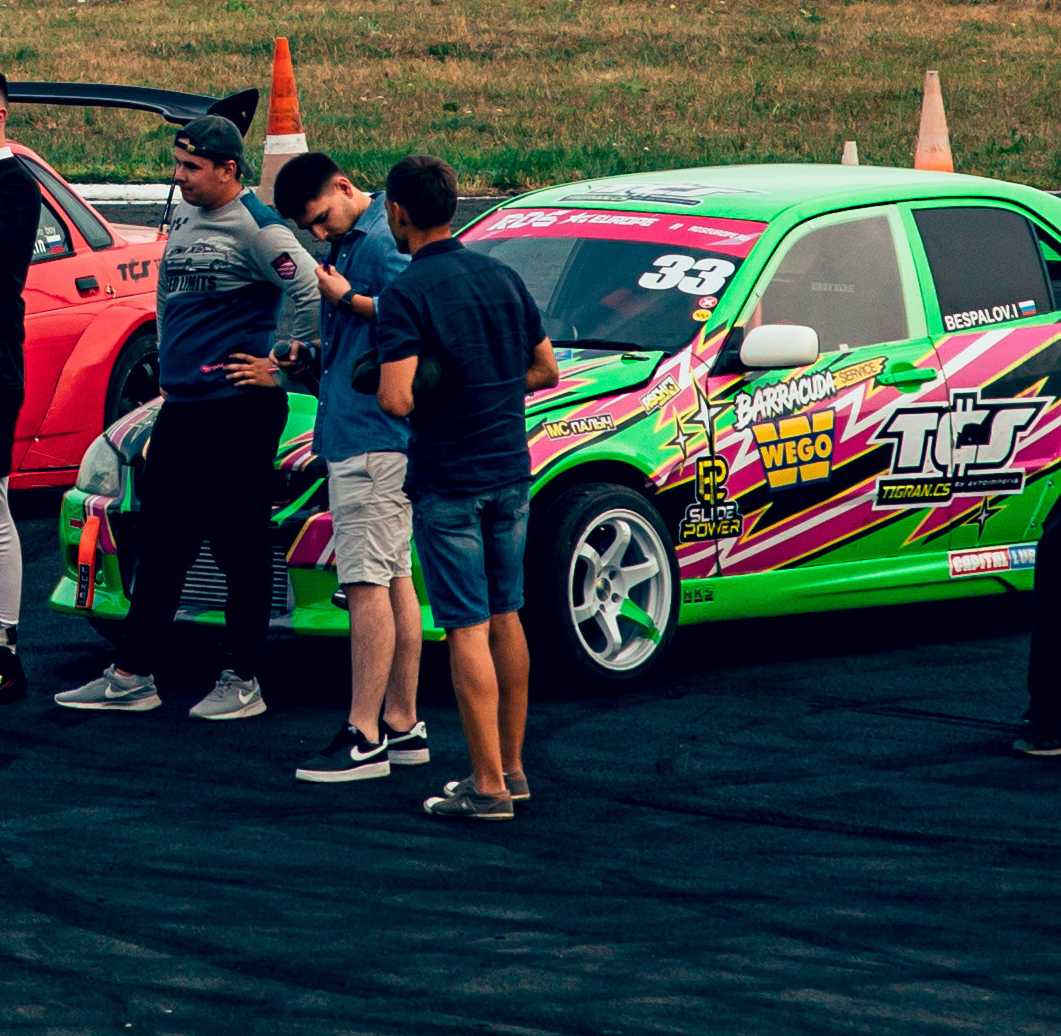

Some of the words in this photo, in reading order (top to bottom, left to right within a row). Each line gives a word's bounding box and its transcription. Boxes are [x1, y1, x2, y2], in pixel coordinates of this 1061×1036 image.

[486, 210, 572, 231] RDS
[589, 214, 660, 227] EUROPE
[178, 275, 218, 291] LIMITS
[638, 254, 736, 296] 33
[945, 303, 1019, 331] BESPALOV.I
[736, 371, 837, 429] BARRACUDA
[839, 362, 878, 383] SERVICE
[887, 399, 1037, 477] TCS
[760, 434, 833, 468] WEGO
[883, 482, 952, 499] TIGRAN.CS
[683, 518, 740, 539] POWER
[952, 550, 1009, 572] CAPITAL
